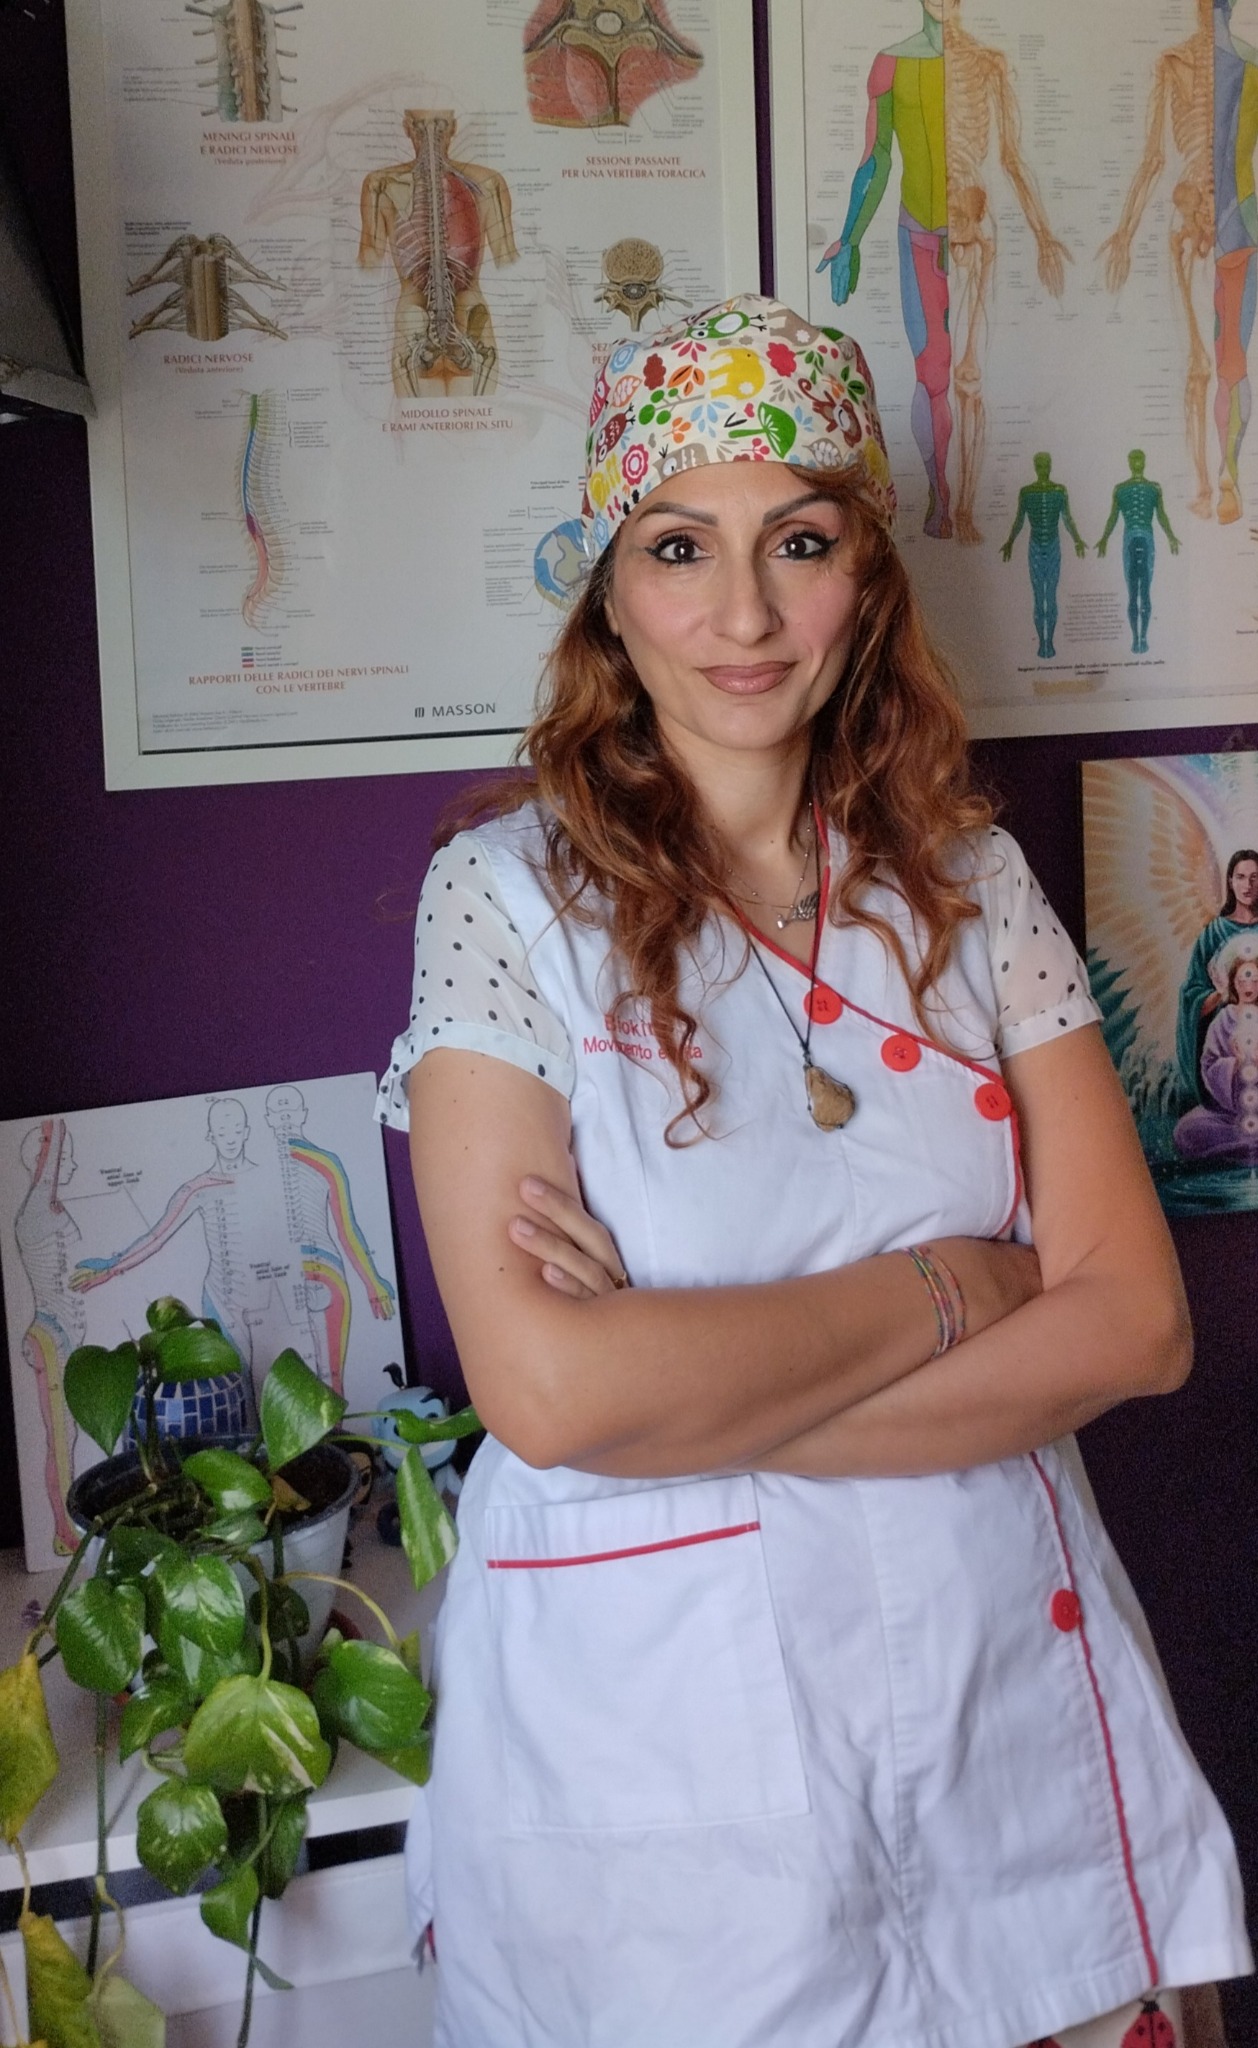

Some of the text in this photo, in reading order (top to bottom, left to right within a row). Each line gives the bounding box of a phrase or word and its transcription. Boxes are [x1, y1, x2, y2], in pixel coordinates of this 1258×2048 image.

[203, 131, 295, 141] MENINGI SPINALI
[209, 145, 247, 155] RADICI
[250, 144, 298, 154] NERVOSE
[585, 155, 681, 166] SESSIONE PASSANTE
[561, 168, 706, 179] PER UNA VERTEBRA TORACICA
[163, 352, 254, 364] RADICI NERVOSE
[401, 407, 493, 419] MIDOLLO SPINALE
[382, 419, 513, 432] E RAMI ANTERIORI IN SITU
[188, 664, 410, 685] RAPPORTI DELLE RADICI DEI NERVI SPINALI
[255, 680, 346, 695] CON LE VERTEBRE
[431, 702, 496, 718] MASSON
